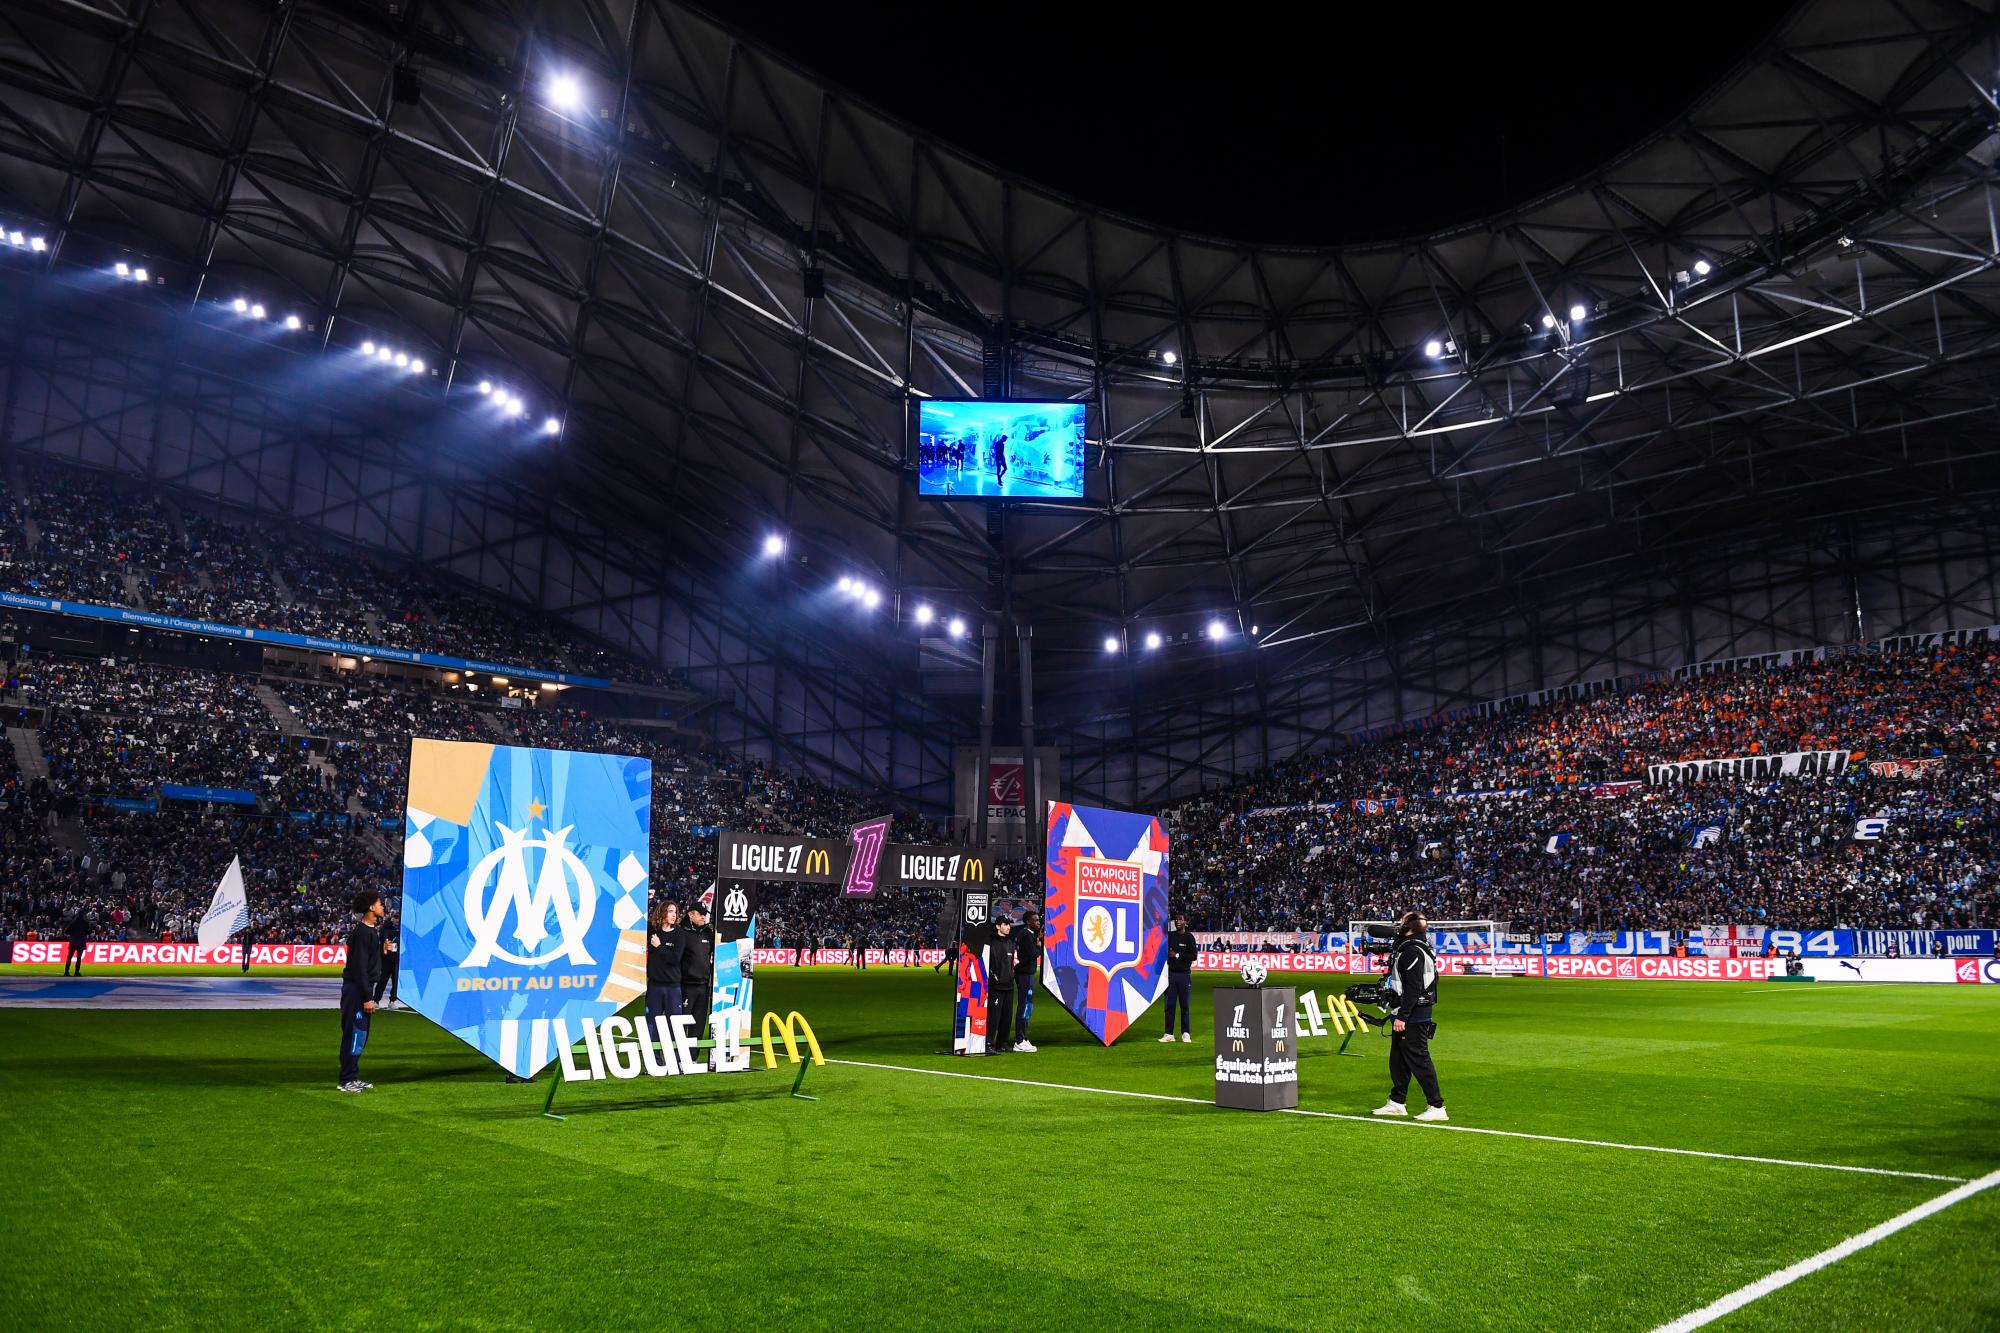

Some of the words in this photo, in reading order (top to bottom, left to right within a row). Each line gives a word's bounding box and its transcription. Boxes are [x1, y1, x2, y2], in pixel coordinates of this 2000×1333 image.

[2, 593, 47, 607] Vélodrome
[122, 611, 162, 624] Bienvenue
[169, 619, 201, 630] l'Orange
[203, 623, 242, 635] Vélodrome
[306, 638, 341, 650] Bienvenue
[731, 843, 785, 873] LIGUE
[900, 854, 945, 881] LIGUE
[1081, 865, 1138, 882] OLYMPIQUE
[1081, 880, 1138, 897] LYONNAIS
[1081, 905, 1135, 954] OL
[1770, 930, 1839, 956] 84
[1946, 934, 1981, 955] pour
[1293, 955, 1347, 971] CEPAC
[1546, 955, 1613, 975] CEPAC
[1640, 957, 1721, 977] CAISSE
[457, 976, 521, 992] DROIT
[526, 975, 553, 990] AU
[559, 974, 598, 989] BUT
[552, 1014, 709, 1082] LIGUE
[1216, 1053, 1262, 1074] Équipier
[1263, 1056, 1297, 1075] Équipier
[1215, 1069, 1229, 1082] du
[1229, 1072, 1263, 1085] match
[1263, 1072, 1274, 1084] du
